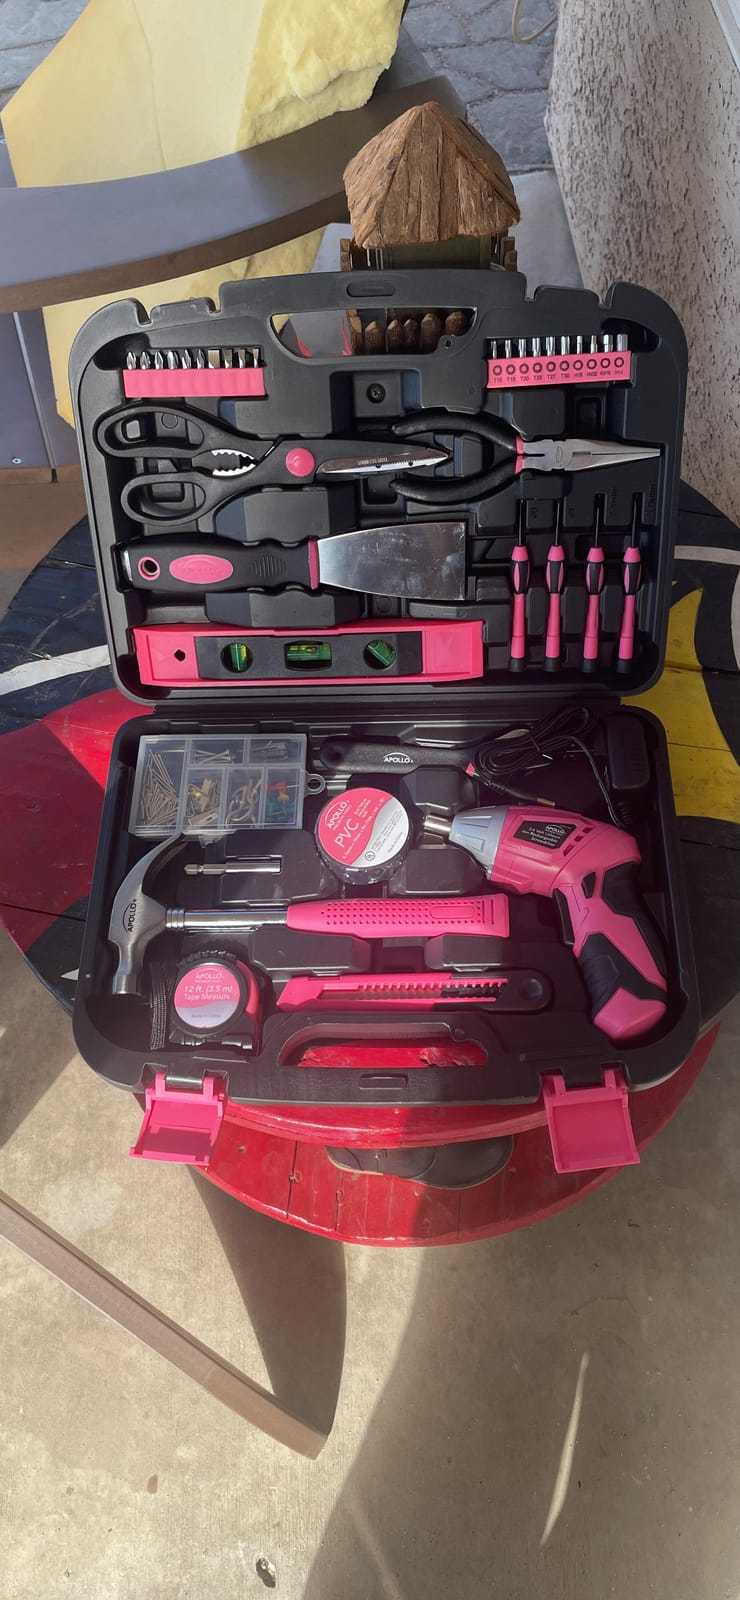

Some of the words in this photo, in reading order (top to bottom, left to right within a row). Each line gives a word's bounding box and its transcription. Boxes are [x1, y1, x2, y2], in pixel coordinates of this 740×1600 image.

[327, 801, 347, 829] APOLLO
[334, 818, 359, 848] PVC
[128, 902, 136, 932] APOLLO
[184, 985, 193, 993] 12
[184, 993, 200, 1002] Tape
